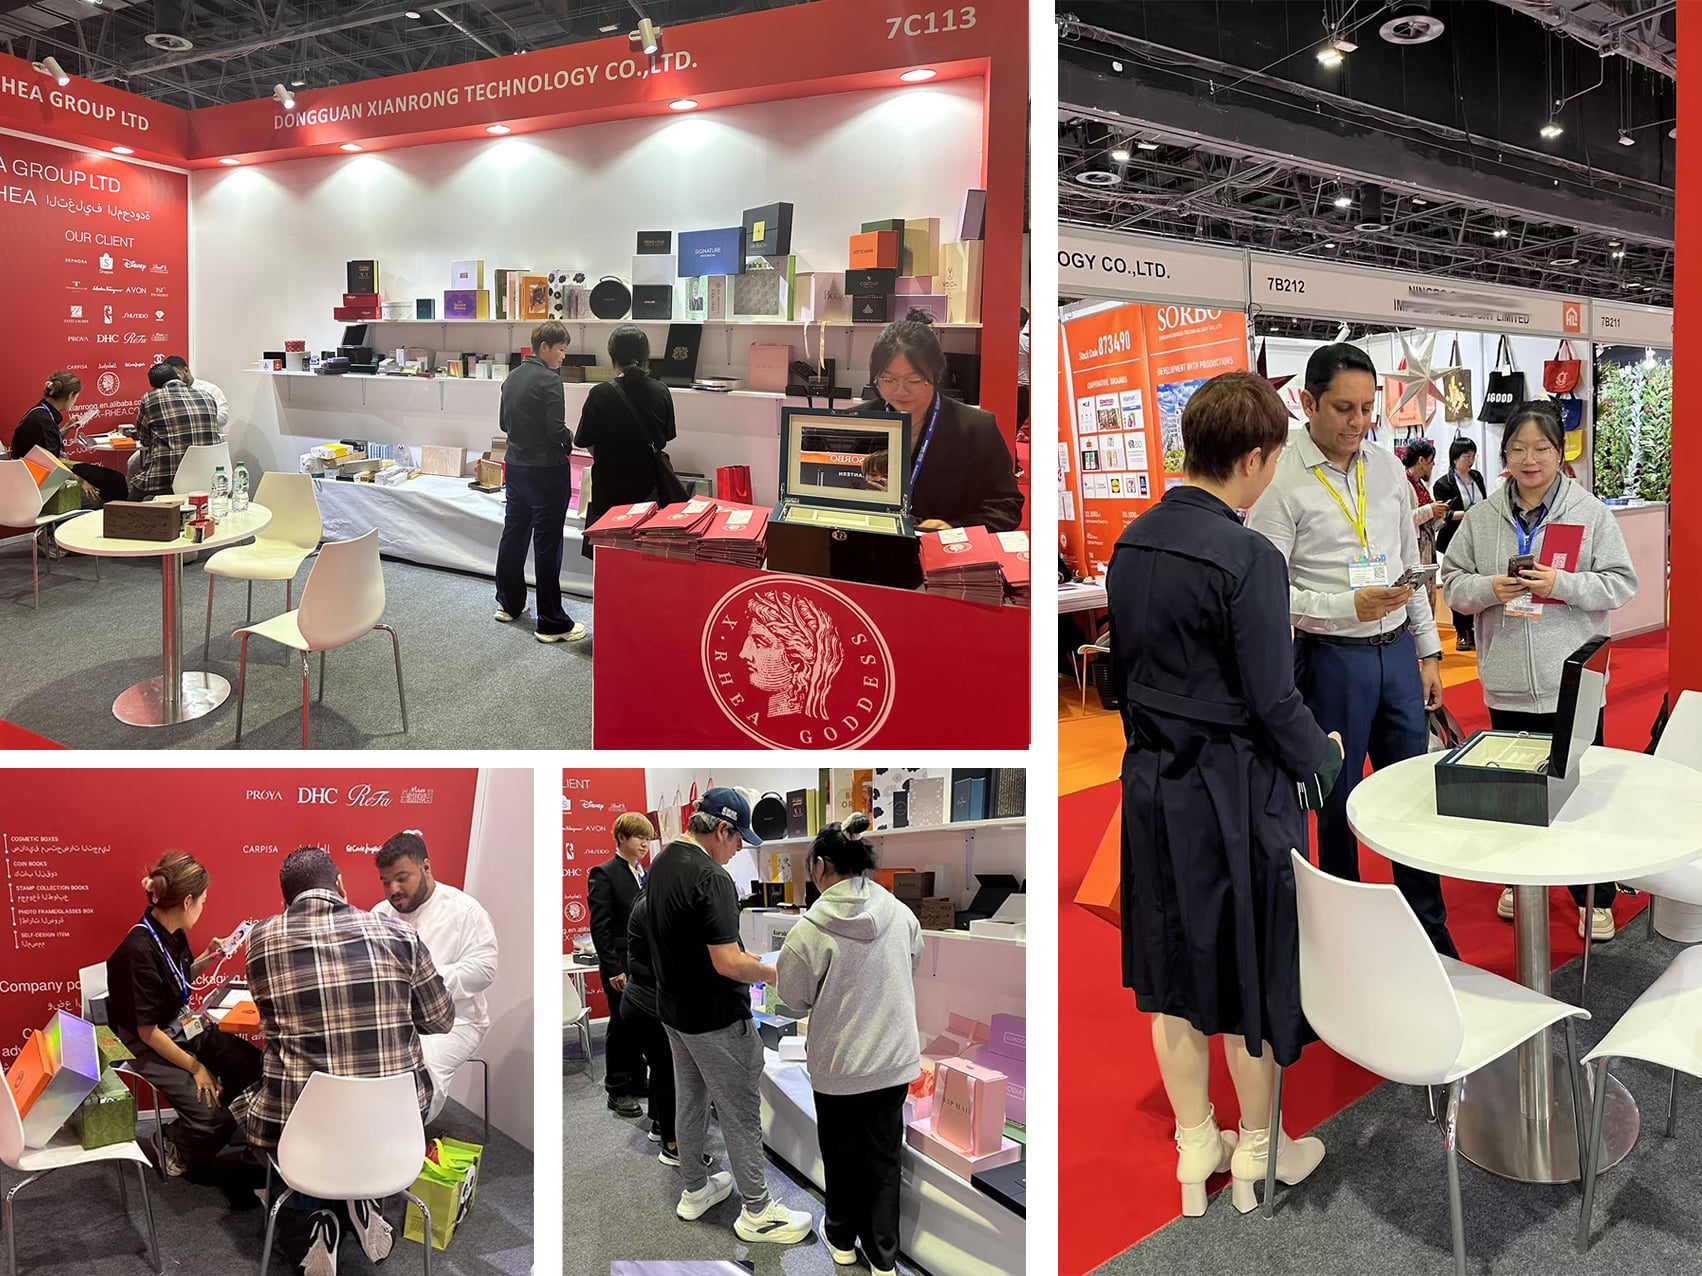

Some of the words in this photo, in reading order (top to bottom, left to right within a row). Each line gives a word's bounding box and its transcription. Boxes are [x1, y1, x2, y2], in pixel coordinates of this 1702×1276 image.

[886, 6, 976, 39] 7C113
[274, 103, 362, 130] DONGGUAN
[367, 88, 459, 116] XIANRONG
[464, 64, 598, 103] TECHNOLOGY
[605, 51, 698, 80] CO.,LTD.
[50, 91, 116, 121] GROUP
[121, 110, 149, 131] LTD
[13, 159, 87, 186] GROUP
[90, 174, 121, 193] LTD
[65, 230, 92, 243] OUR
[95, 233, 135, 248] CLIENT
[1102, 256, 1170, 279] CO.,LTD.
[126, 286, 147, 294] AVON
[1267, 277, 1305, 293] 7B212
[1601, 317, 1621, 327] 7B211
[97, 334, 119, 343] DHC
[1098, 330, 1131, 356] 873490
[799, 632, 879, 744] GODDESS
[246, 790, 283, 800] PROYA
[298, 787, 338, 804] DHC
[345, 784, 393, 807] ReFa
[242, 845, 279, 854] CARPISA
[0, 979, 63, 994] Company
